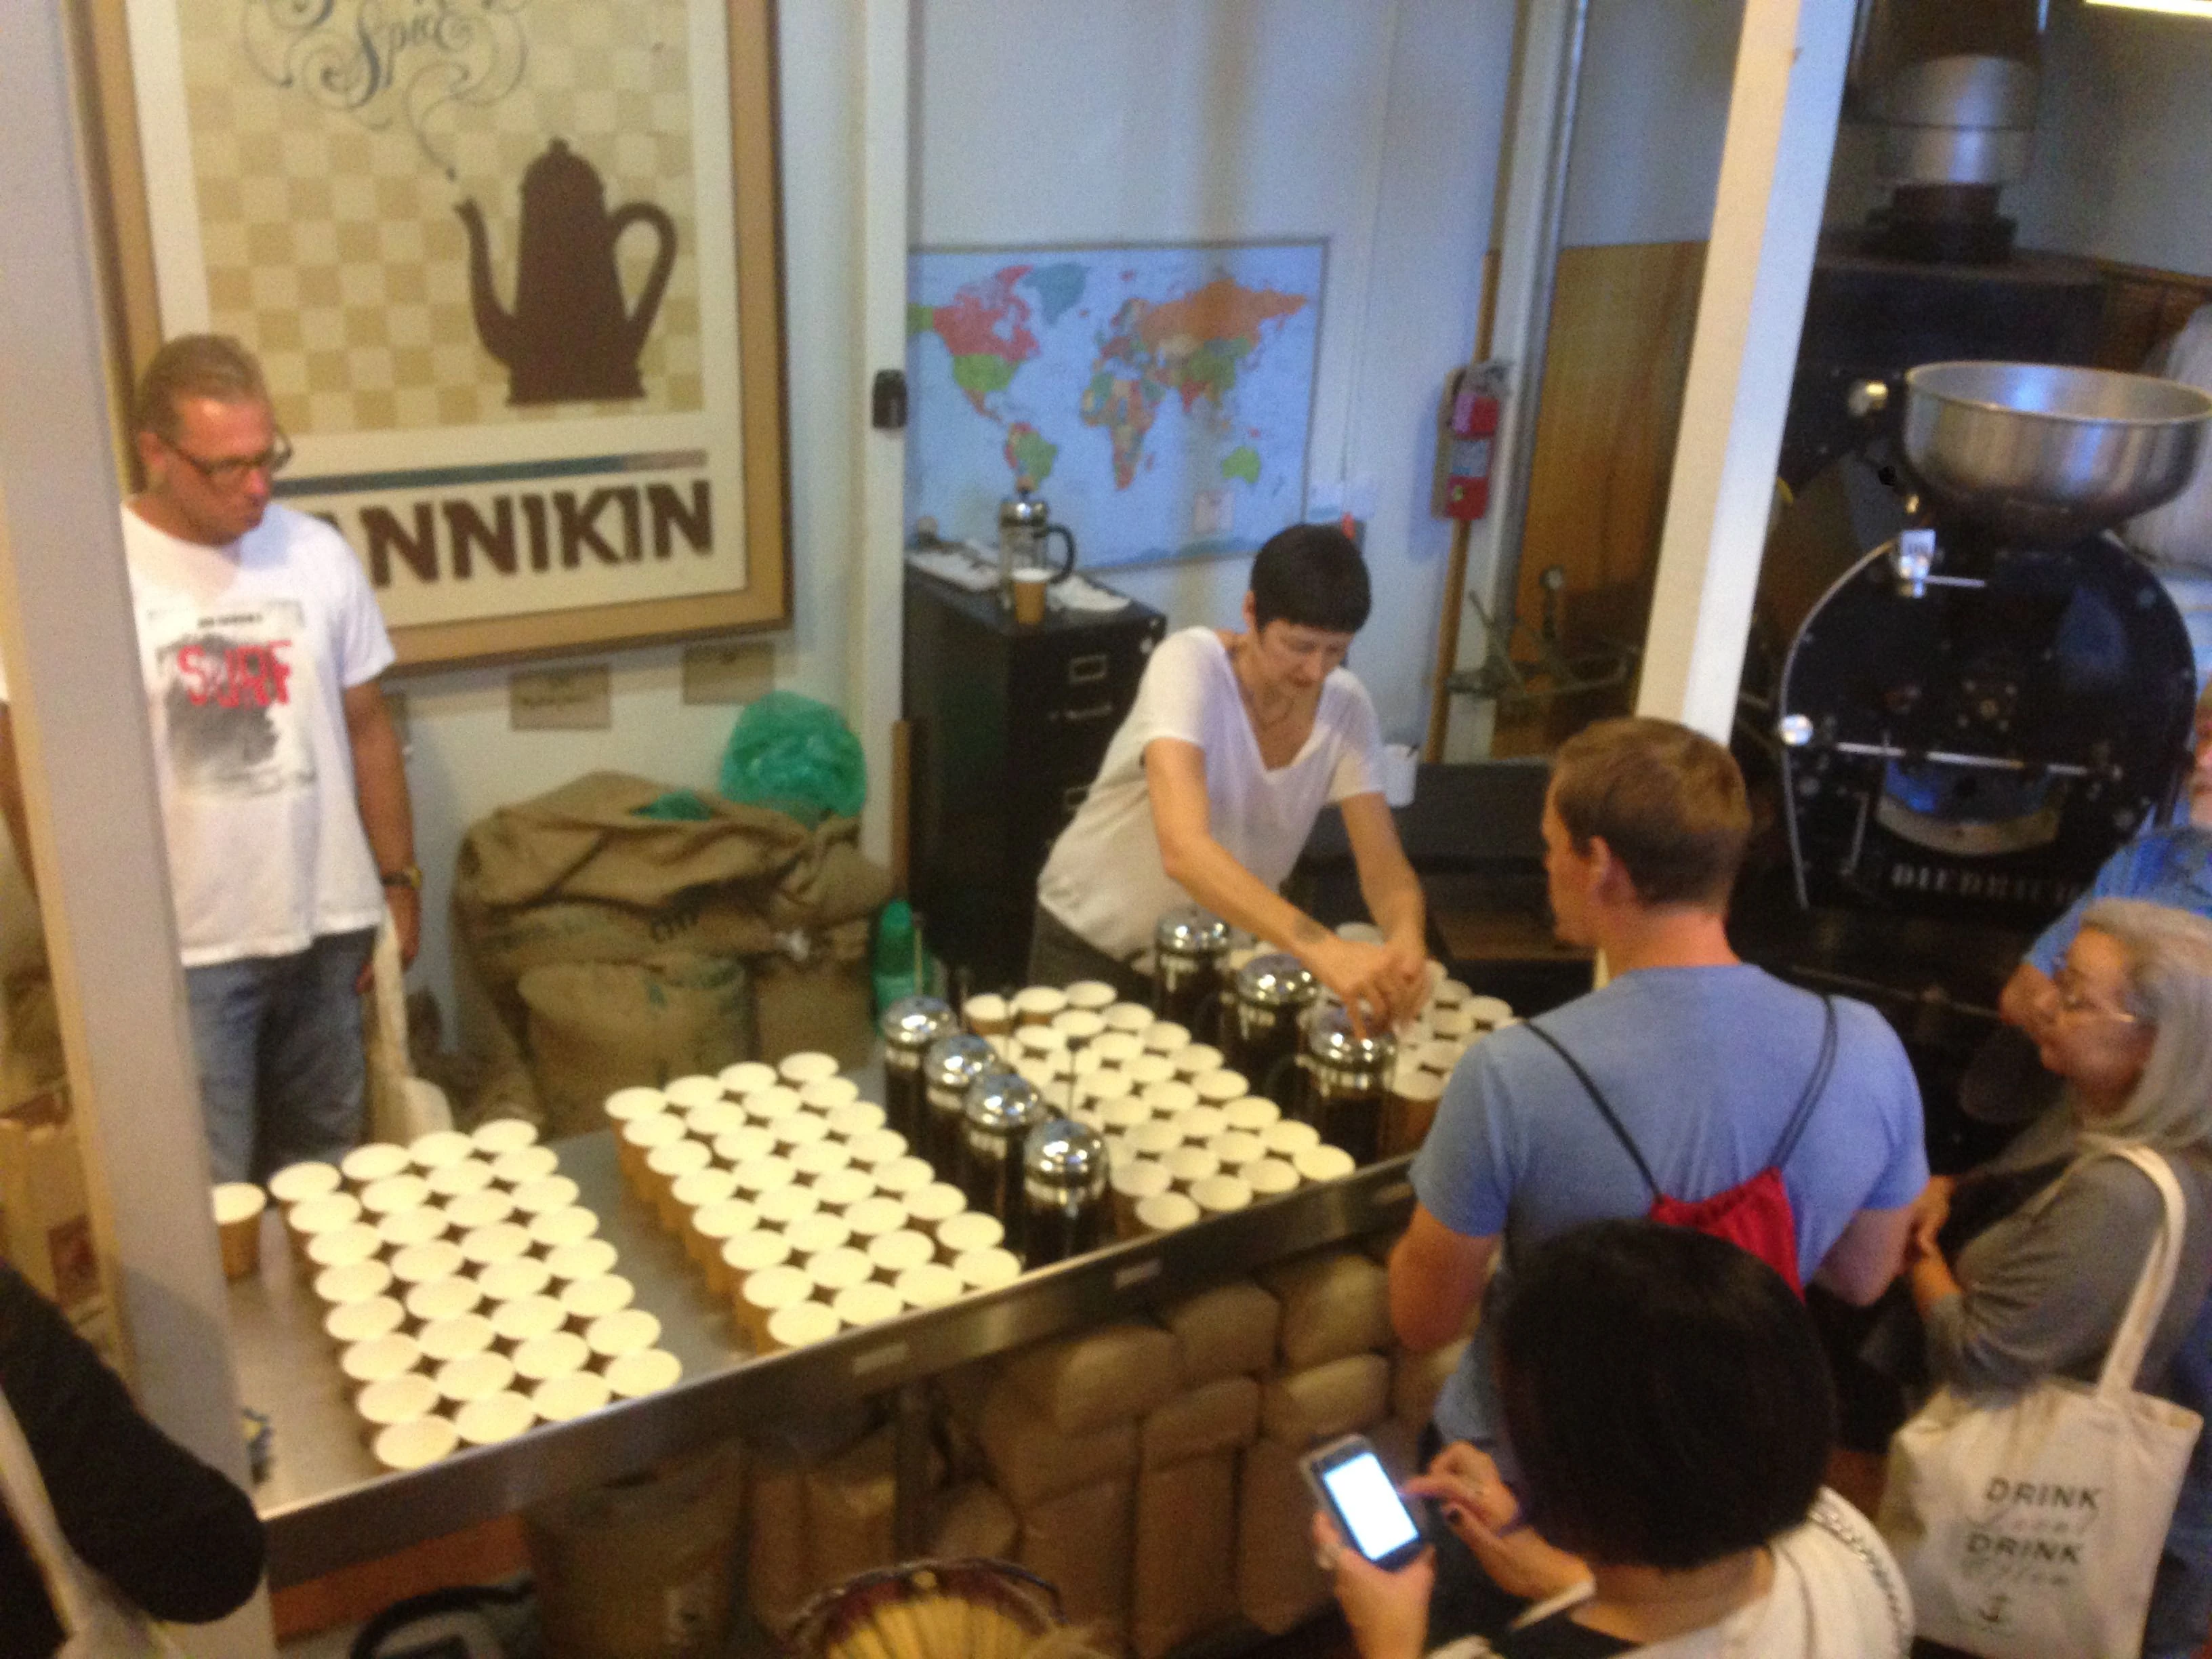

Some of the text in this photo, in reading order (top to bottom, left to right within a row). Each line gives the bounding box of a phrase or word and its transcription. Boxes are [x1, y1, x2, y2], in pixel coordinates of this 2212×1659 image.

[310, 478, 716, 588] NNIKIN
[1986, 1475, 2102, 1511] DRINK
[1966, 1532, 2084, 1565] DRINK
